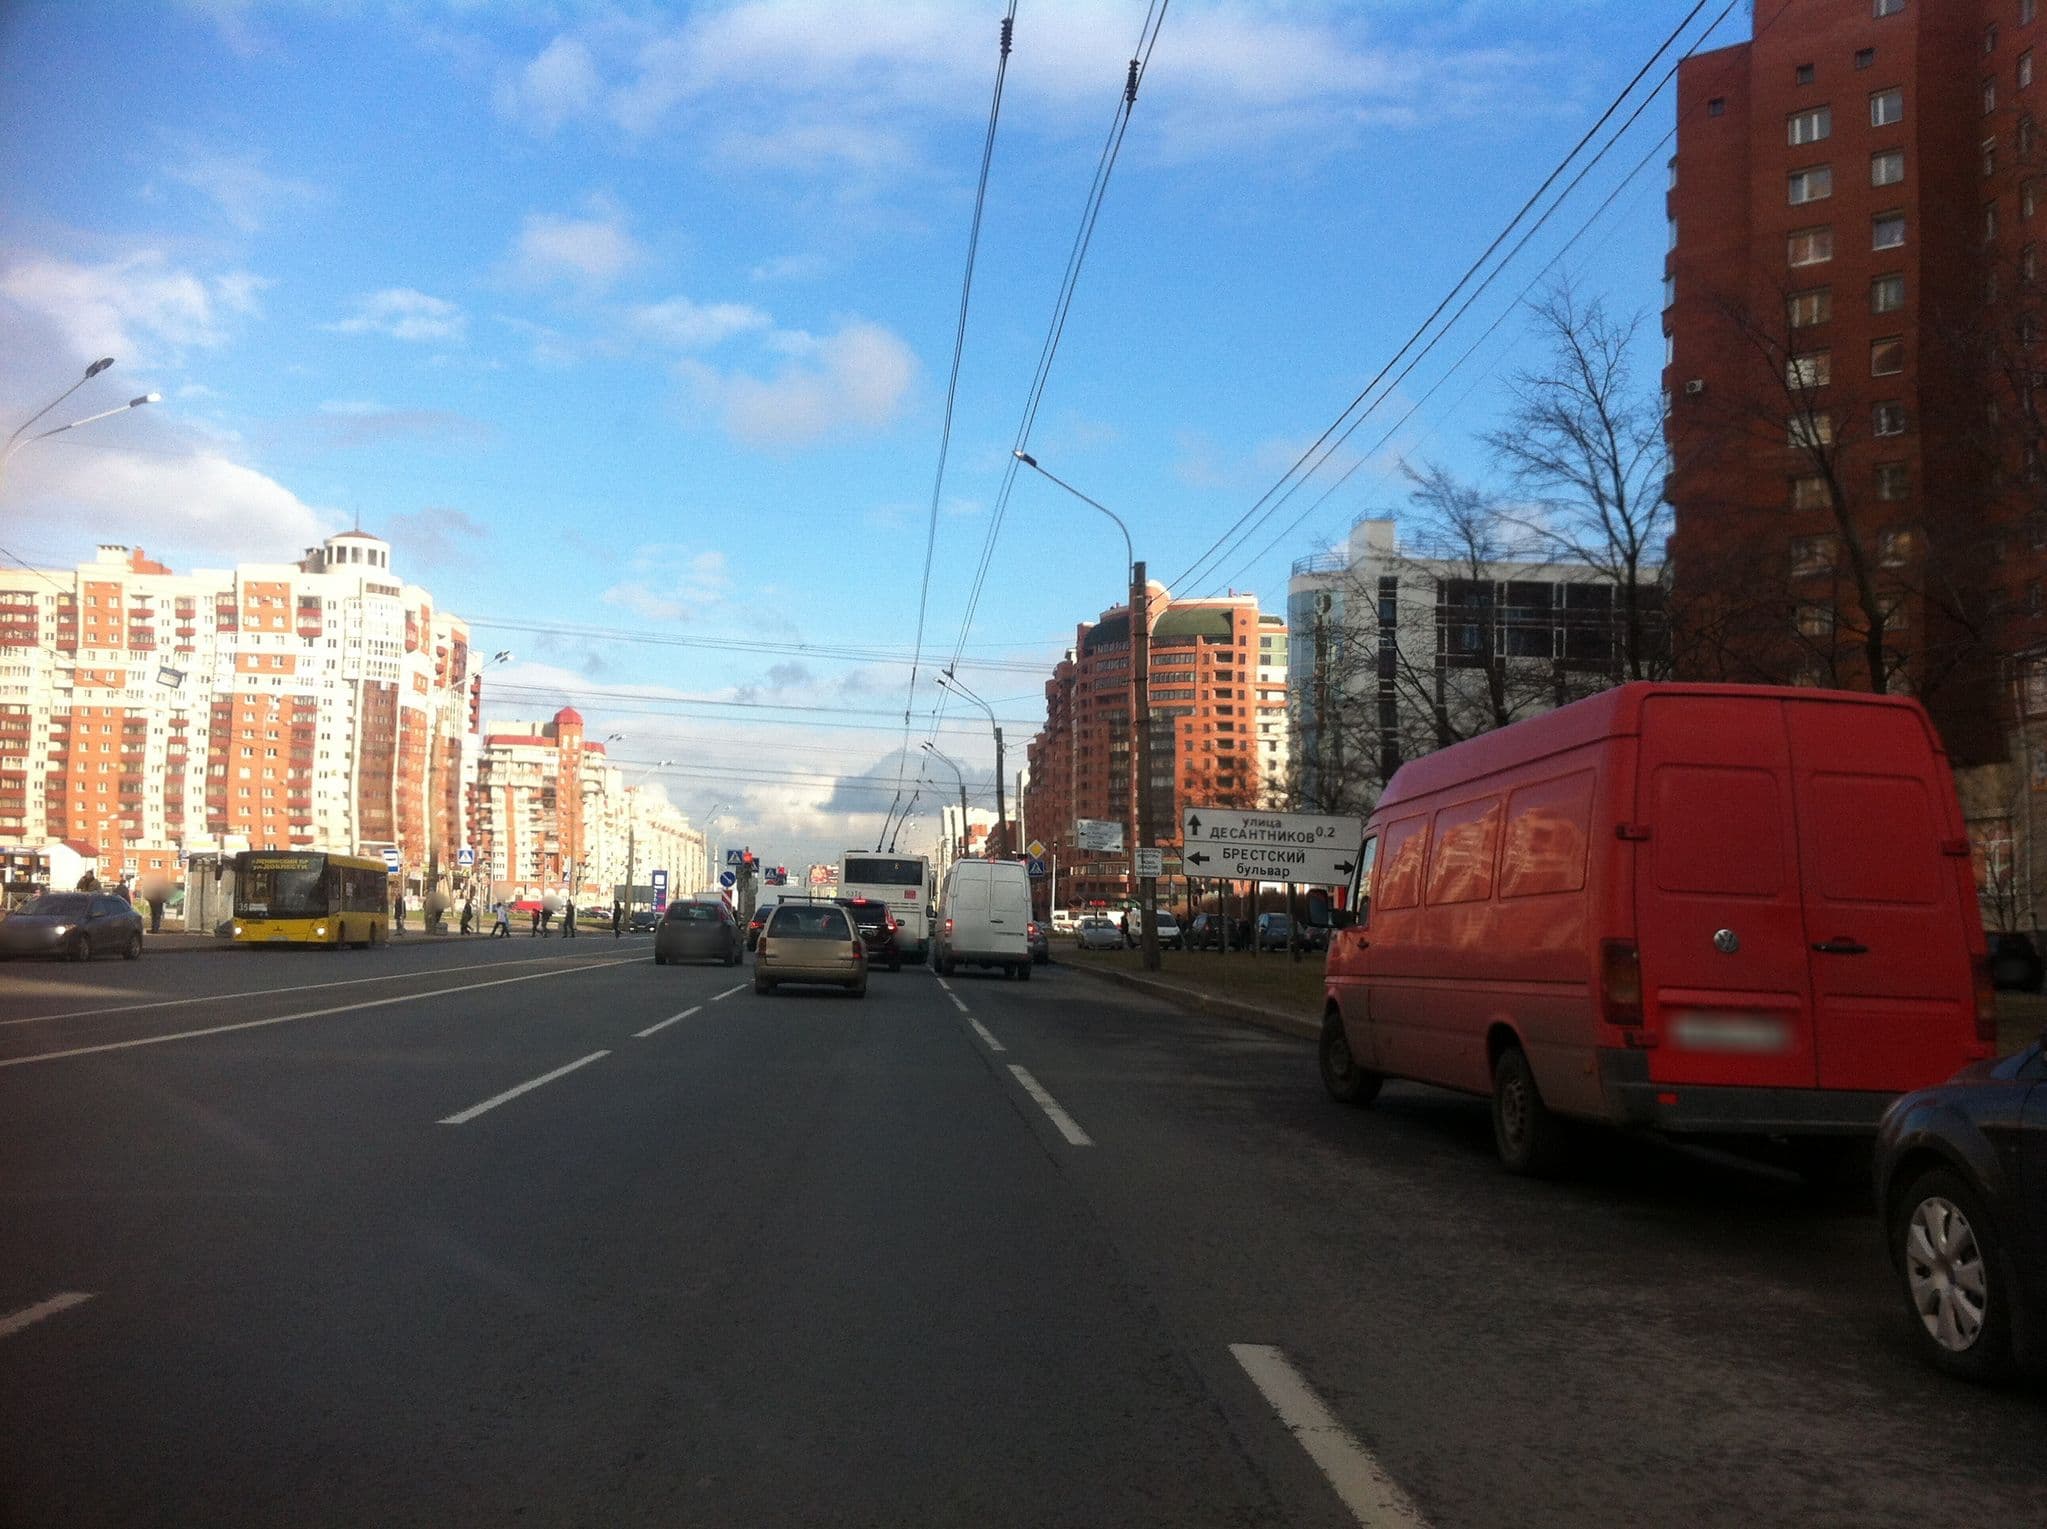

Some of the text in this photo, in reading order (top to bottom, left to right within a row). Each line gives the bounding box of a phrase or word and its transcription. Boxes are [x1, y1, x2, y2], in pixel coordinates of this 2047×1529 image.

[1242, 817, 1282, 828] улица
[1210, 827, 1315, 843] ДЕСАНТНИКОВ
[1223, 848, 1305, 863] БРЕСТСКИЙ
[1236, 863, 1290, 878] бульвар
